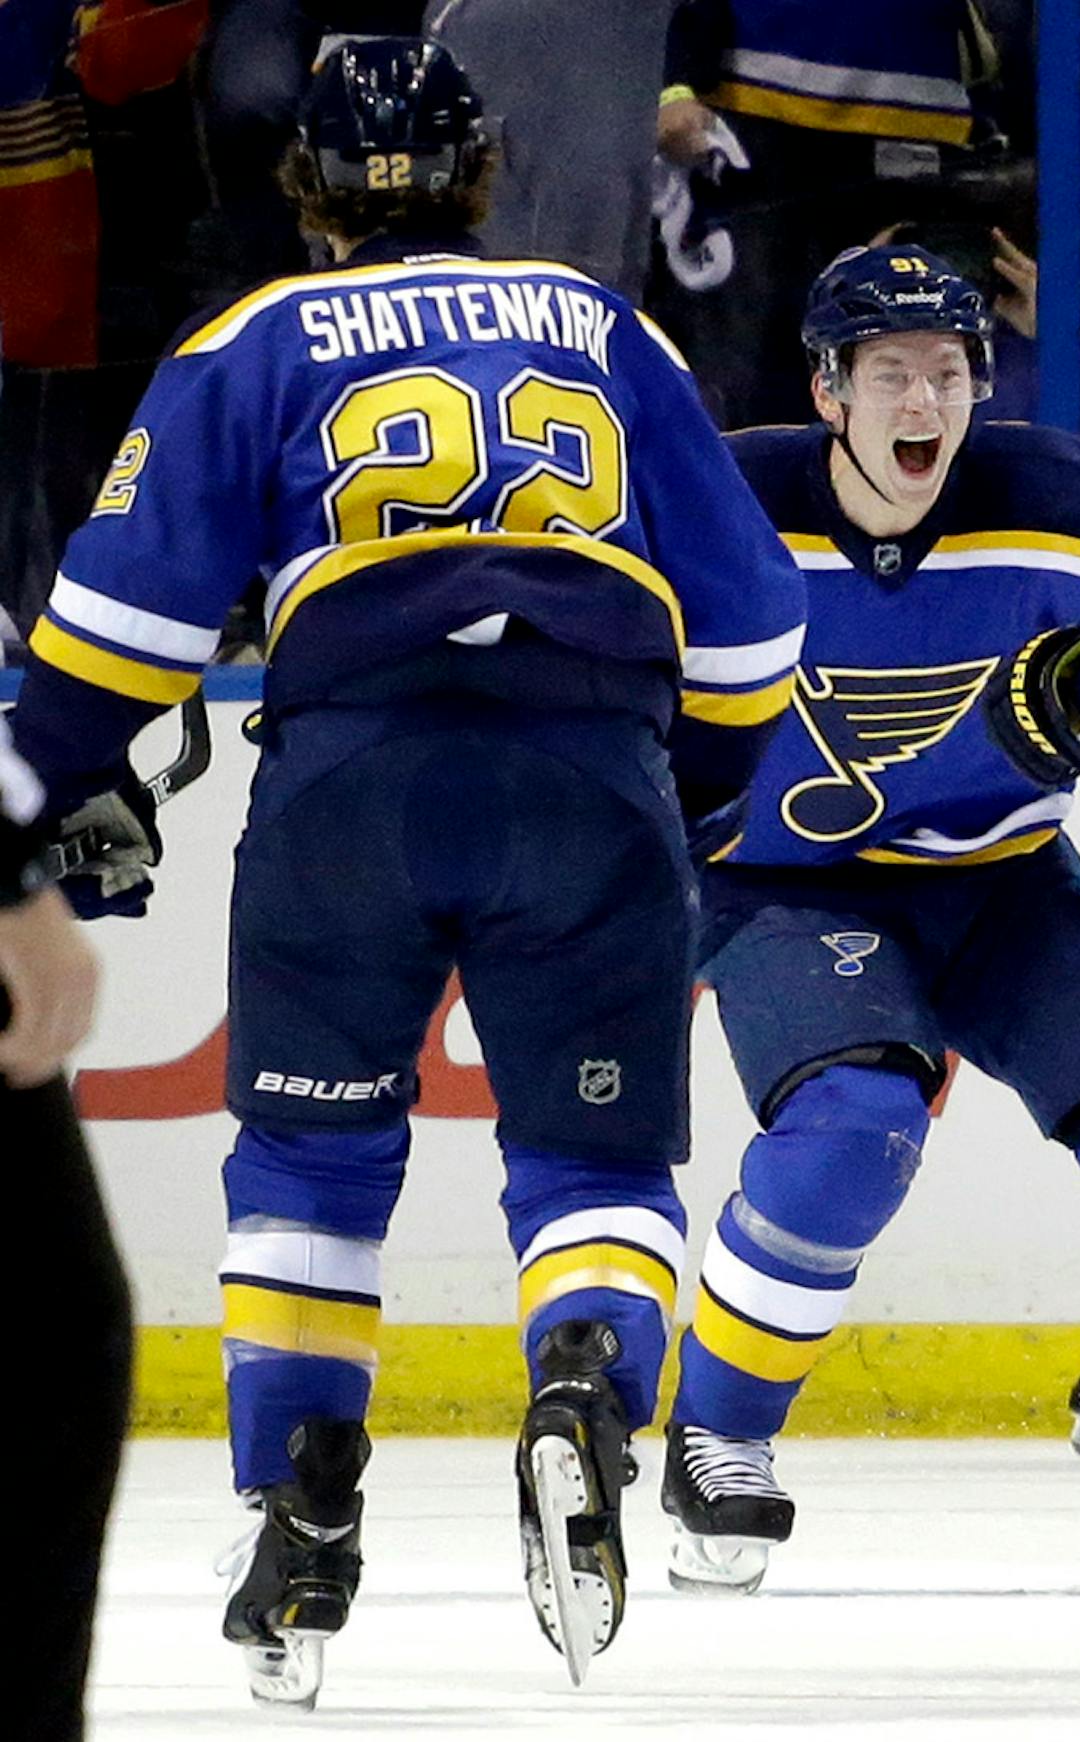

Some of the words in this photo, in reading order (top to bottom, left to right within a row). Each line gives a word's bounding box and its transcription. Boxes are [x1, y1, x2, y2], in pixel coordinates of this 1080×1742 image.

[366, 152, 413, 190] 22
[889, 256, 929, 276] 91
[319, 365, 627, 547] 22
